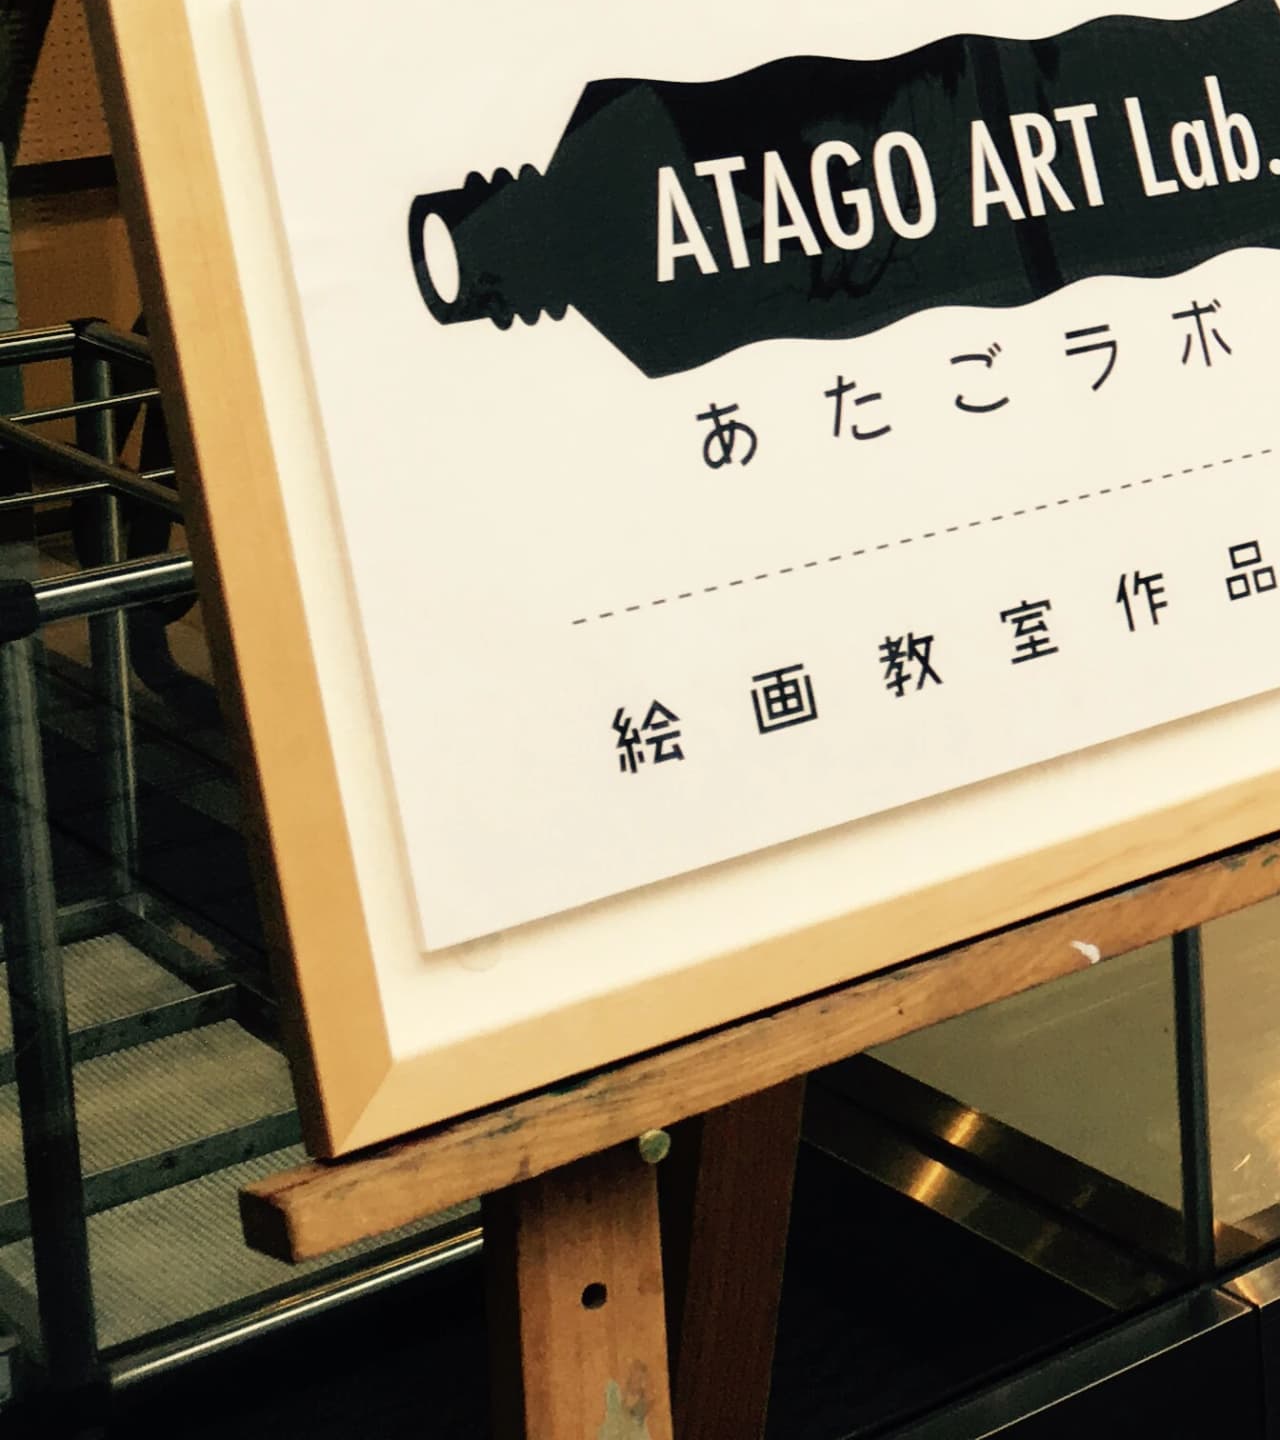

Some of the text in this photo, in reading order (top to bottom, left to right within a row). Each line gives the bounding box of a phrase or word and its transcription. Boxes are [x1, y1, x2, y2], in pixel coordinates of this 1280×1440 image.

[656, 130, 938, 283] ATAGO
[970, 102, 1106, 228] ART
[695, 298, 1234, 471] あたごラボ
